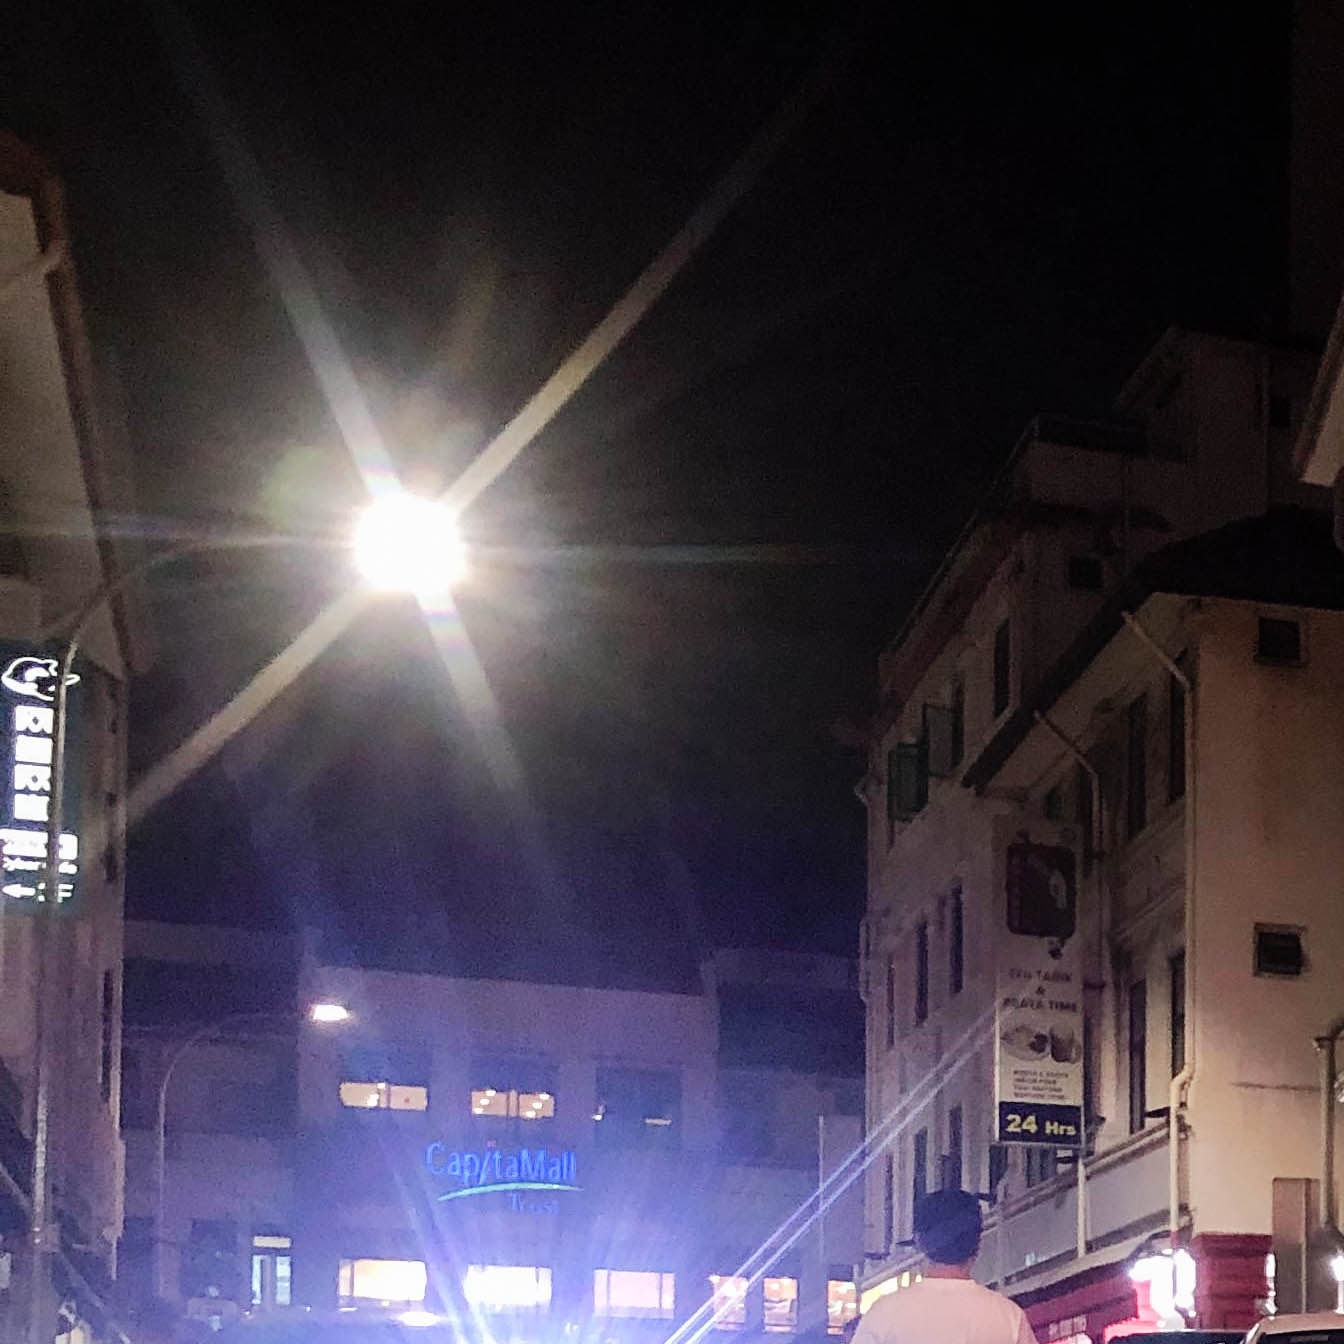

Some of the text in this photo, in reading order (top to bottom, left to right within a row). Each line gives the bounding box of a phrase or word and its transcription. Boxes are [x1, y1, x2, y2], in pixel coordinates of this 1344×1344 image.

[1006, 1113, 1076, 1136] 24 Hrs
[425, 1139, 577, 1186] CapitaMall
